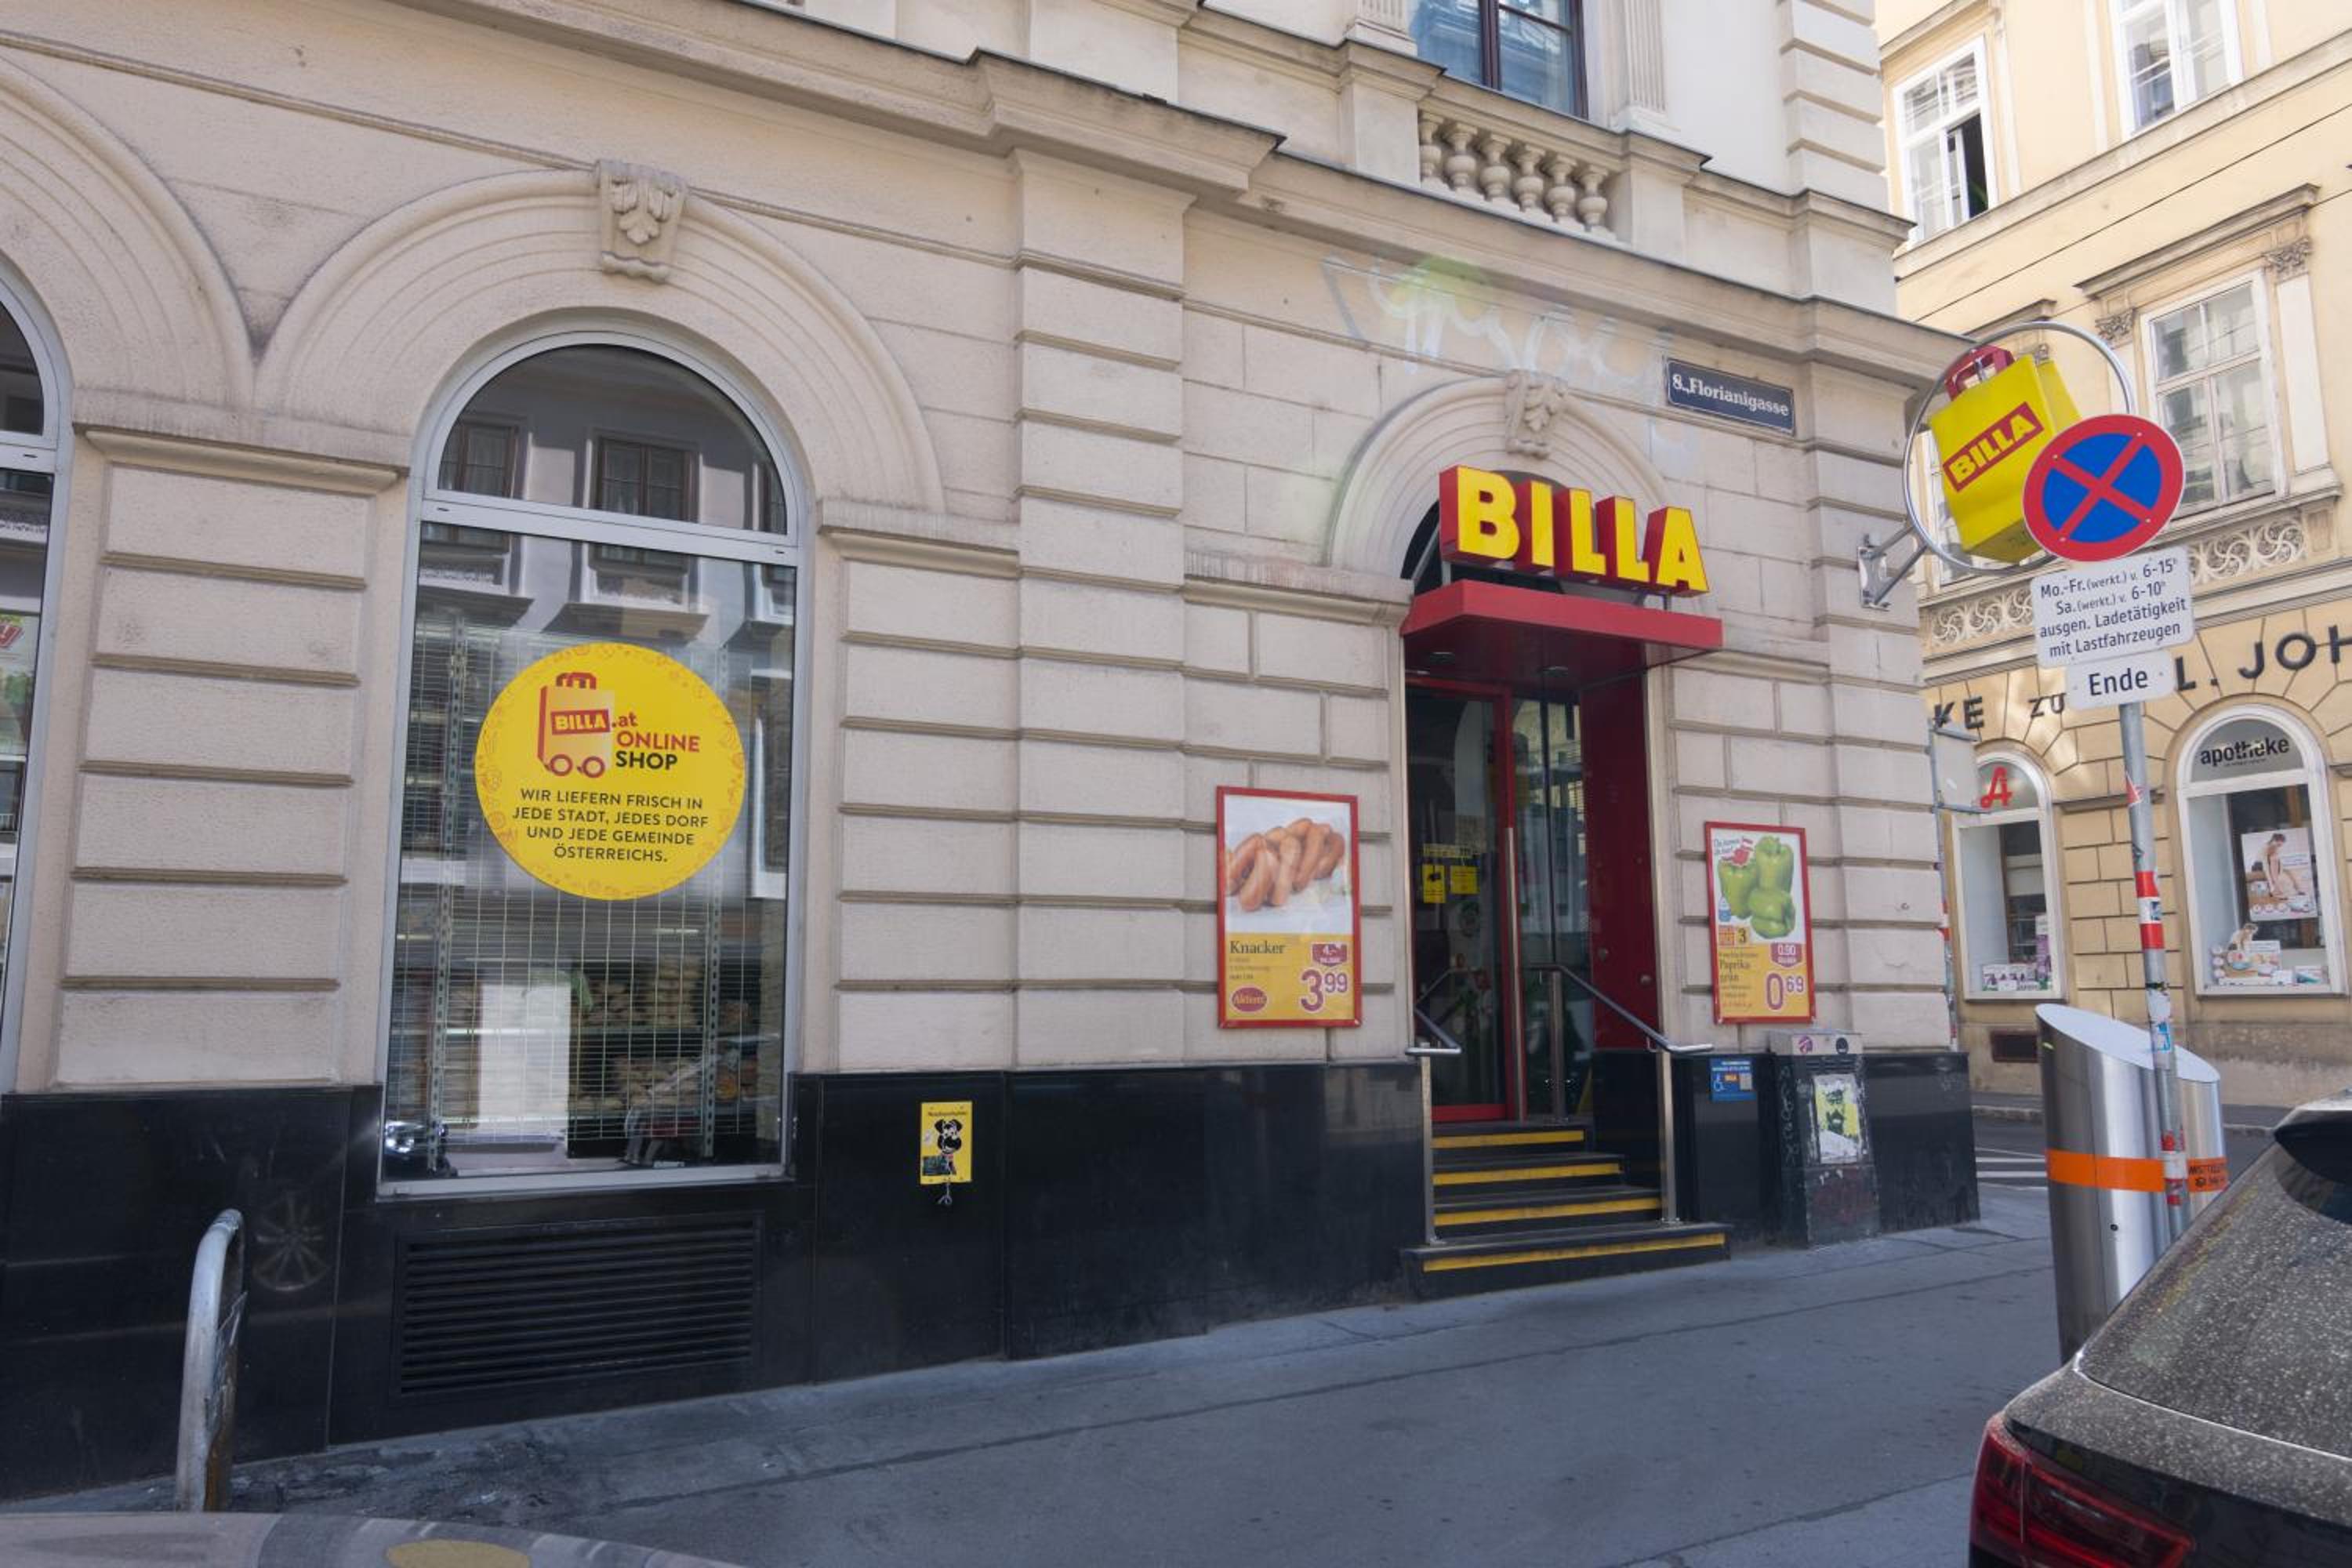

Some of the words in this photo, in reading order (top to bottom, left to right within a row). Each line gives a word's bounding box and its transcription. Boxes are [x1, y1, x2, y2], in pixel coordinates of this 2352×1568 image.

[1687, 377, 1789, 416] Florianigasse
[1948, 414, 2037, 481] BILLA
[1439, 465, 1710, 597] BILLA
[2040, 619, 2091, 639] ausgen.
[2095, 597, 2187, 628] Ladetätigkeit
[2049, 642, 2072, 658] mit
[2075, 622, 2181, 654] Lastfahrzeugen
[2089, 667, 2149, 696] Ende
[617, 730, 701, 753] ONLINE
[2200, 737, 2290, 768] apotheke
[615, 750, 678, 770] SHOP
[520, 788, 551, 802] WIR
[557, 790, 622, 805] LIEFERN
[626, 794, 682, 809] FRISCH
[687, 797, 702, 810] IN
[512, 808, 553, 821] JEDE
[557, 809, 609, 824] STADT,
[614, 811, 660, 826] JEDES
[666, 815, 709, 828] DORF
[526, 826, 564, 840] UND
[568, 828, 608, 841] JEDE
[612, 830, 695, 845] GEMEINDE
[554, 843, 668, 862] ÖSTERREICHS.
[1229, 940, 1287, 954] Knacker
